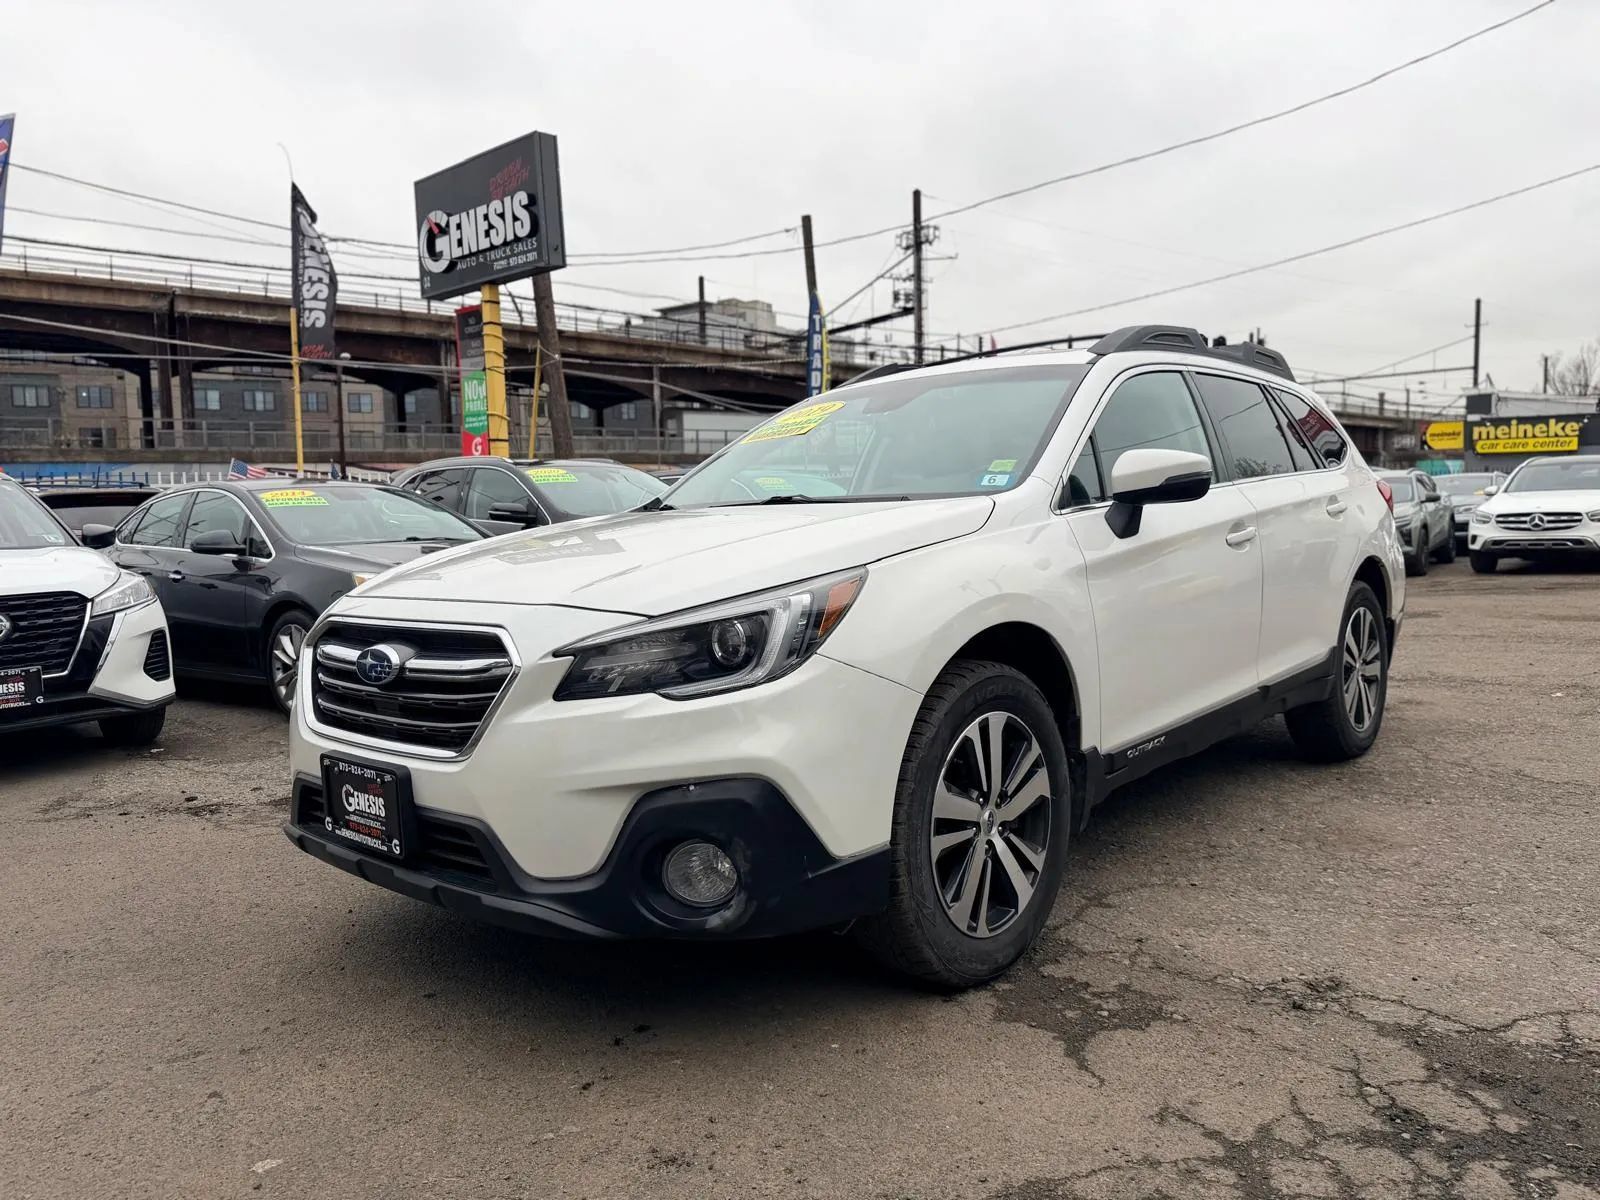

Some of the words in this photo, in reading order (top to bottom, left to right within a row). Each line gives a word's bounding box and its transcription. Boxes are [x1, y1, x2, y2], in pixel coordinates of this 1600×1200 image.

[419, 190, 531, 274] GENESIS
[457, 255, 477, 271] AUTO
[486, 247, 512, 262] TRUCK
[513, 238, 538, 253] SALES
[1472, 418, 1580, 441] meineke
[472, 437, 483, 455] G
[1480, 441, 1499, 450] car
[1502, 440, 1529, 450] care
[1533, 438, 1574, 449] center
[987, 475, 998, 484] 6
[270, 490, 306, 498] 2014
[35, 695, 44, 704] G
[341, 784, 386, 817] GENESIS
[324, 816, 333, 831] G
[391, 839, 401, 855] G
